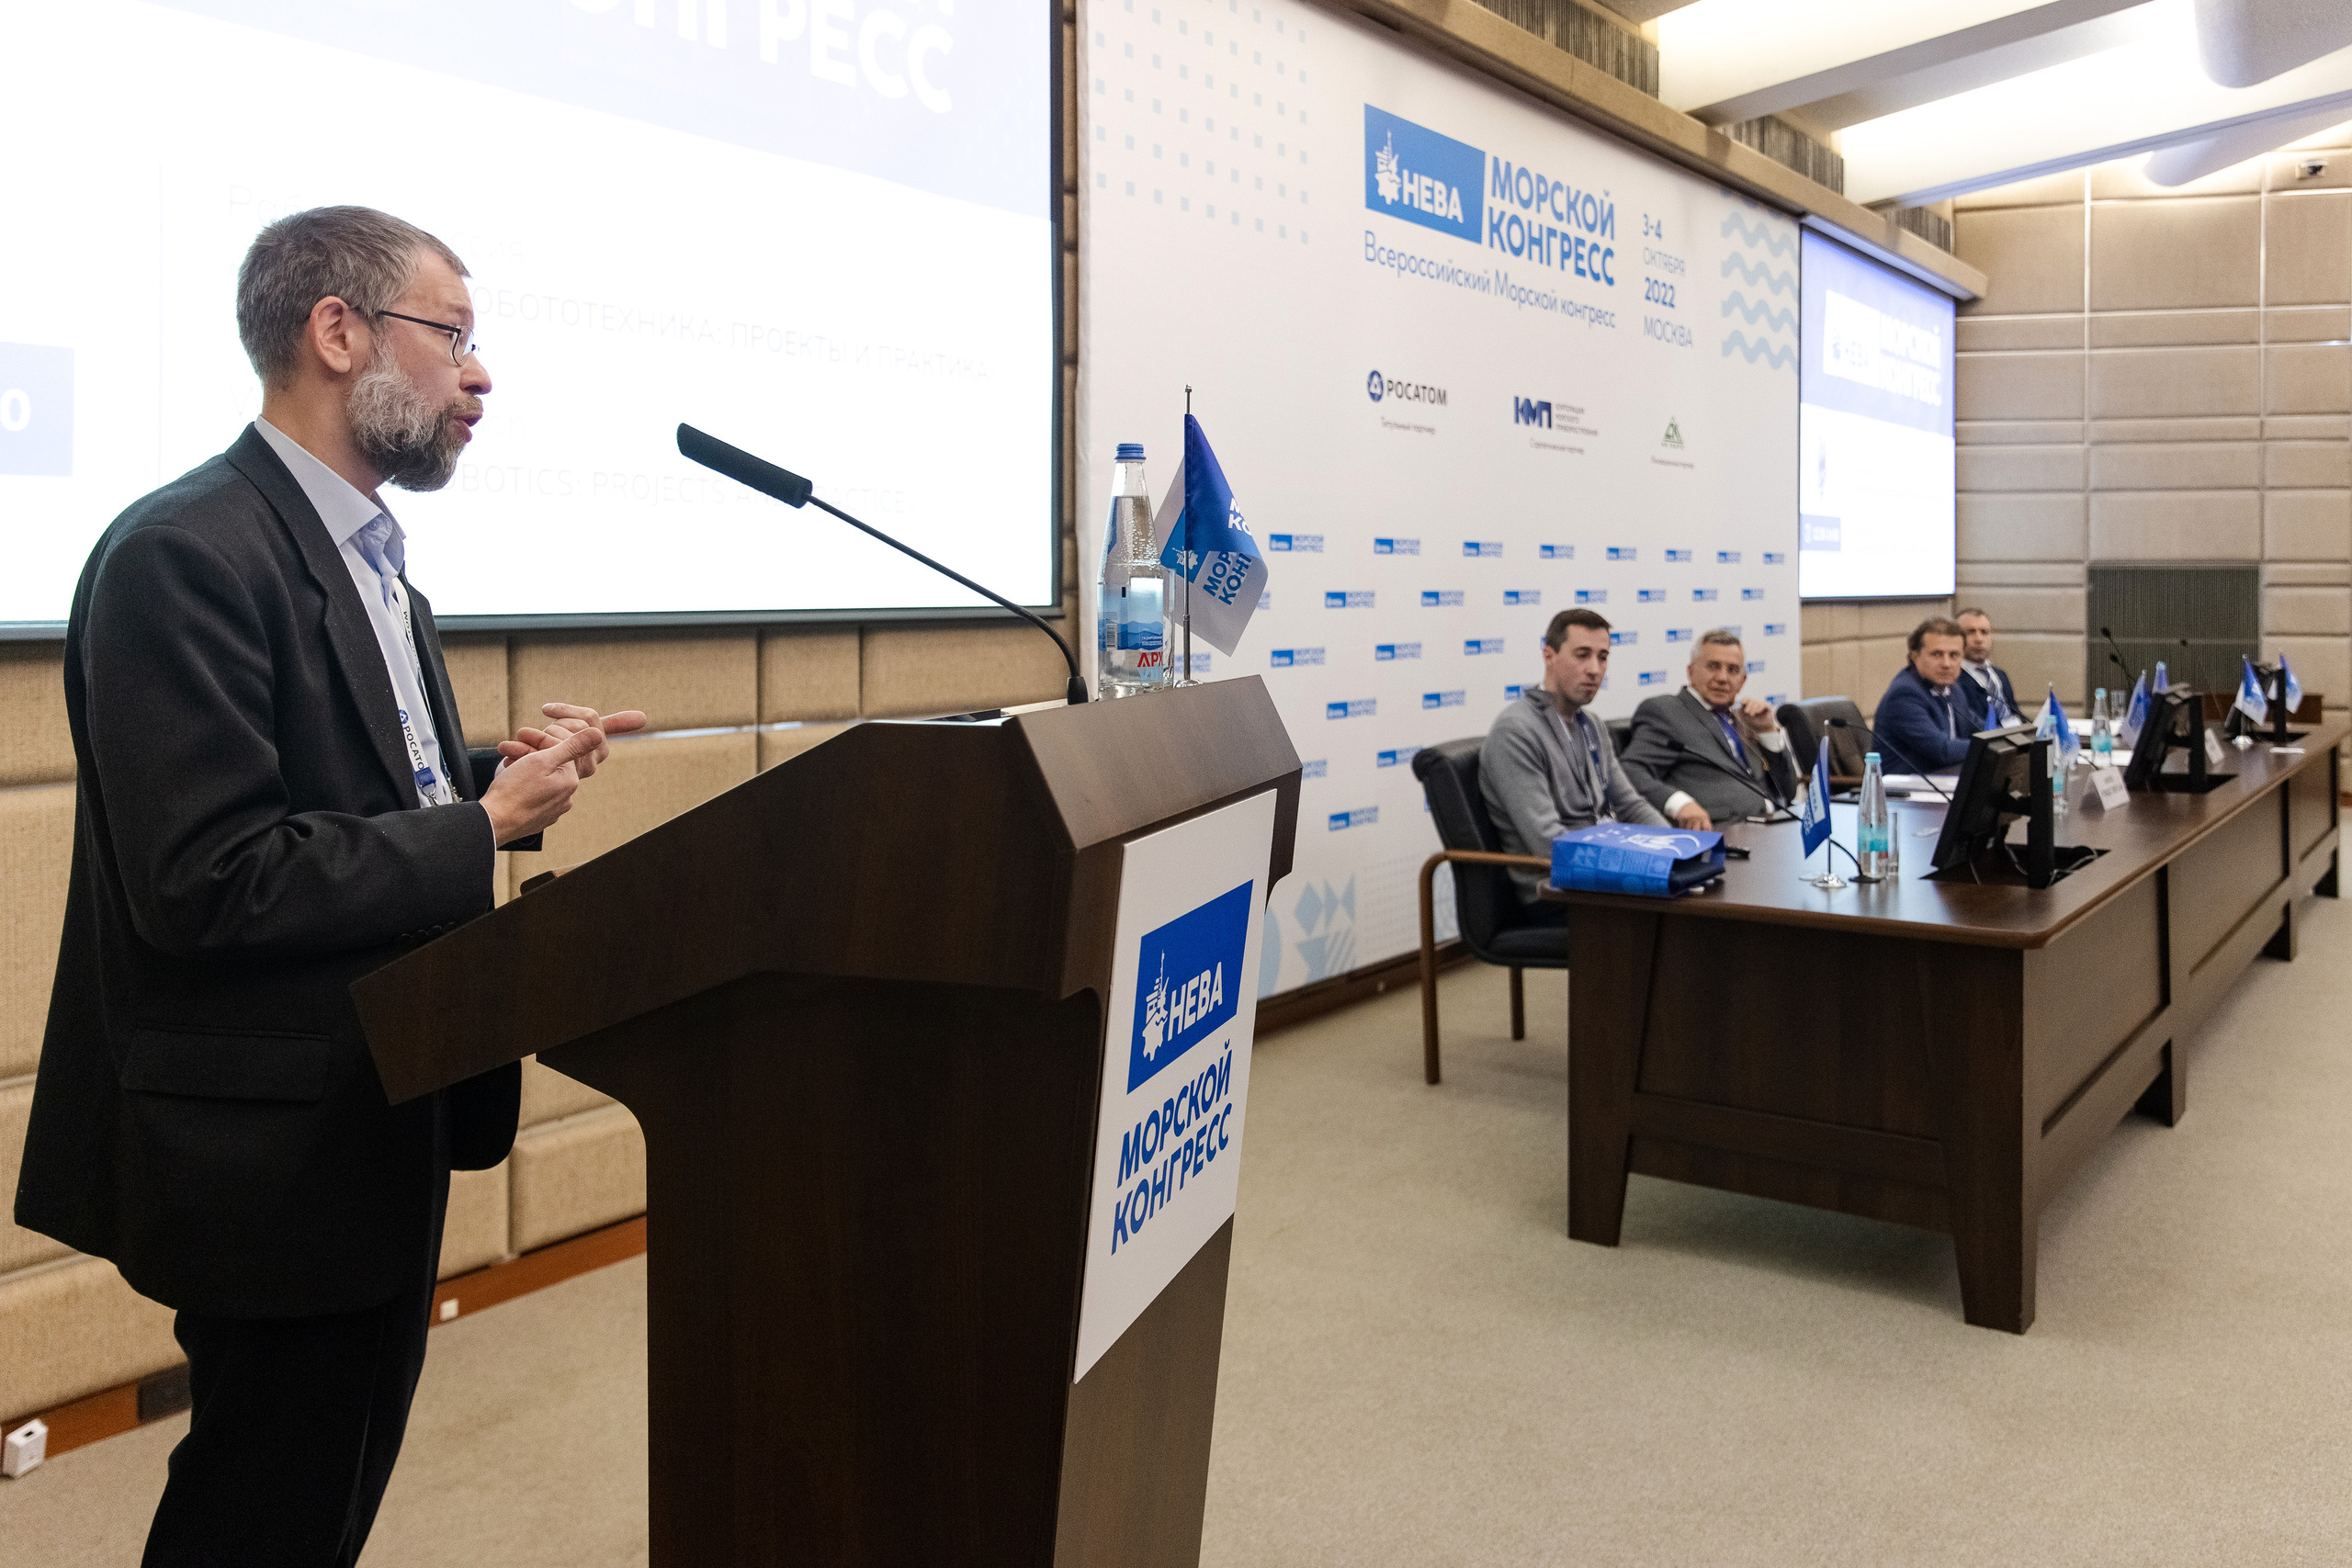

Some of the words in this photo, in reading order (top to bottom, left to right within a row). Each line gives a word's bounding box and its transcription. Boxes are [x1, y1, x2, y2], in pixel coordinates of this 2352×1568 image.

[570, 0, 954, 114] РЕСС
[1402, 169, 1464, 224] НЕВА
[1491, 155, 1614, 241] МОРСКОЙ
[1643, 213, 1662, 241] 3-4
[1488, 206, 1614, 287] КОНГРЕСС
[1643, 246, 1685, 276] ОКТЯБРЯ
[1364, 230, 1490, 295] Всероссийский
[1494, 268, 1559, 313] Морской
[1561, 297, 1616, 330] конгресс
[1644, 276, 1676, 310] 2022
[472, 287, 721, 346] ОБОТОТЕХНИКА:
[731, 321, 846, 364] ПРОЕКТЫ
[1644, 315, 1693, 349] МОСКВА
[1386, 379, 1447, 407] РОСАТОМ
[444, 463, 581, 498] BOTICS:
[593, 471, 726, 508] PROJECTS
[403, 725, 424, 770] РОСАТО
[1167, 961, 1223, 1042] НЕВА
[1116, 1037, 1233, 1190] МОРСКОЙ
[1110, 1102, 1233, 1257] КОНГРЕСС
